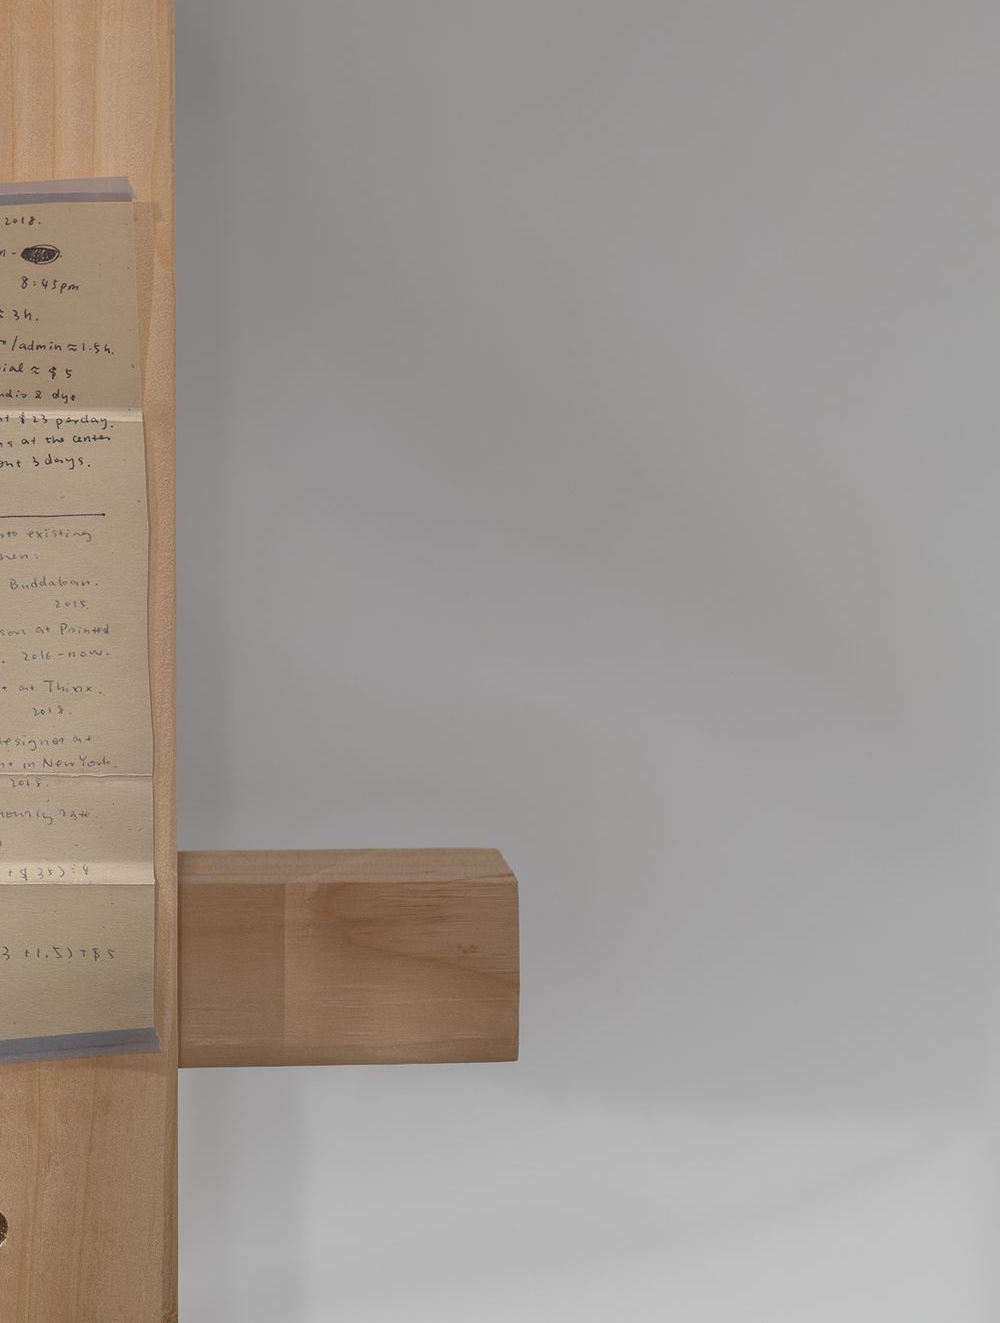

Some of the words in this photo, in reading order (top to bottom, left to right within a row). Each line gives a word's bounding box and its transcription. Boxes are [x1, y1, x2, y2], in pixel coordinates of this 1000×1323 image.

[21, 276, 79, 294] 8:45pm
[52, 389, 76, 404] dye
[21, 436, 36, 445] at
[45, 435, 64, 444] the
[45, 453, 90, 470] days.
[27, 529, 92, 542] existing
[36, 625, 50, 635] at
[19, 684, 34, 692] at
[73, 734, 91, 744] at
[23, 761, 35, 770] in
[43, 758, 75, 768] New
